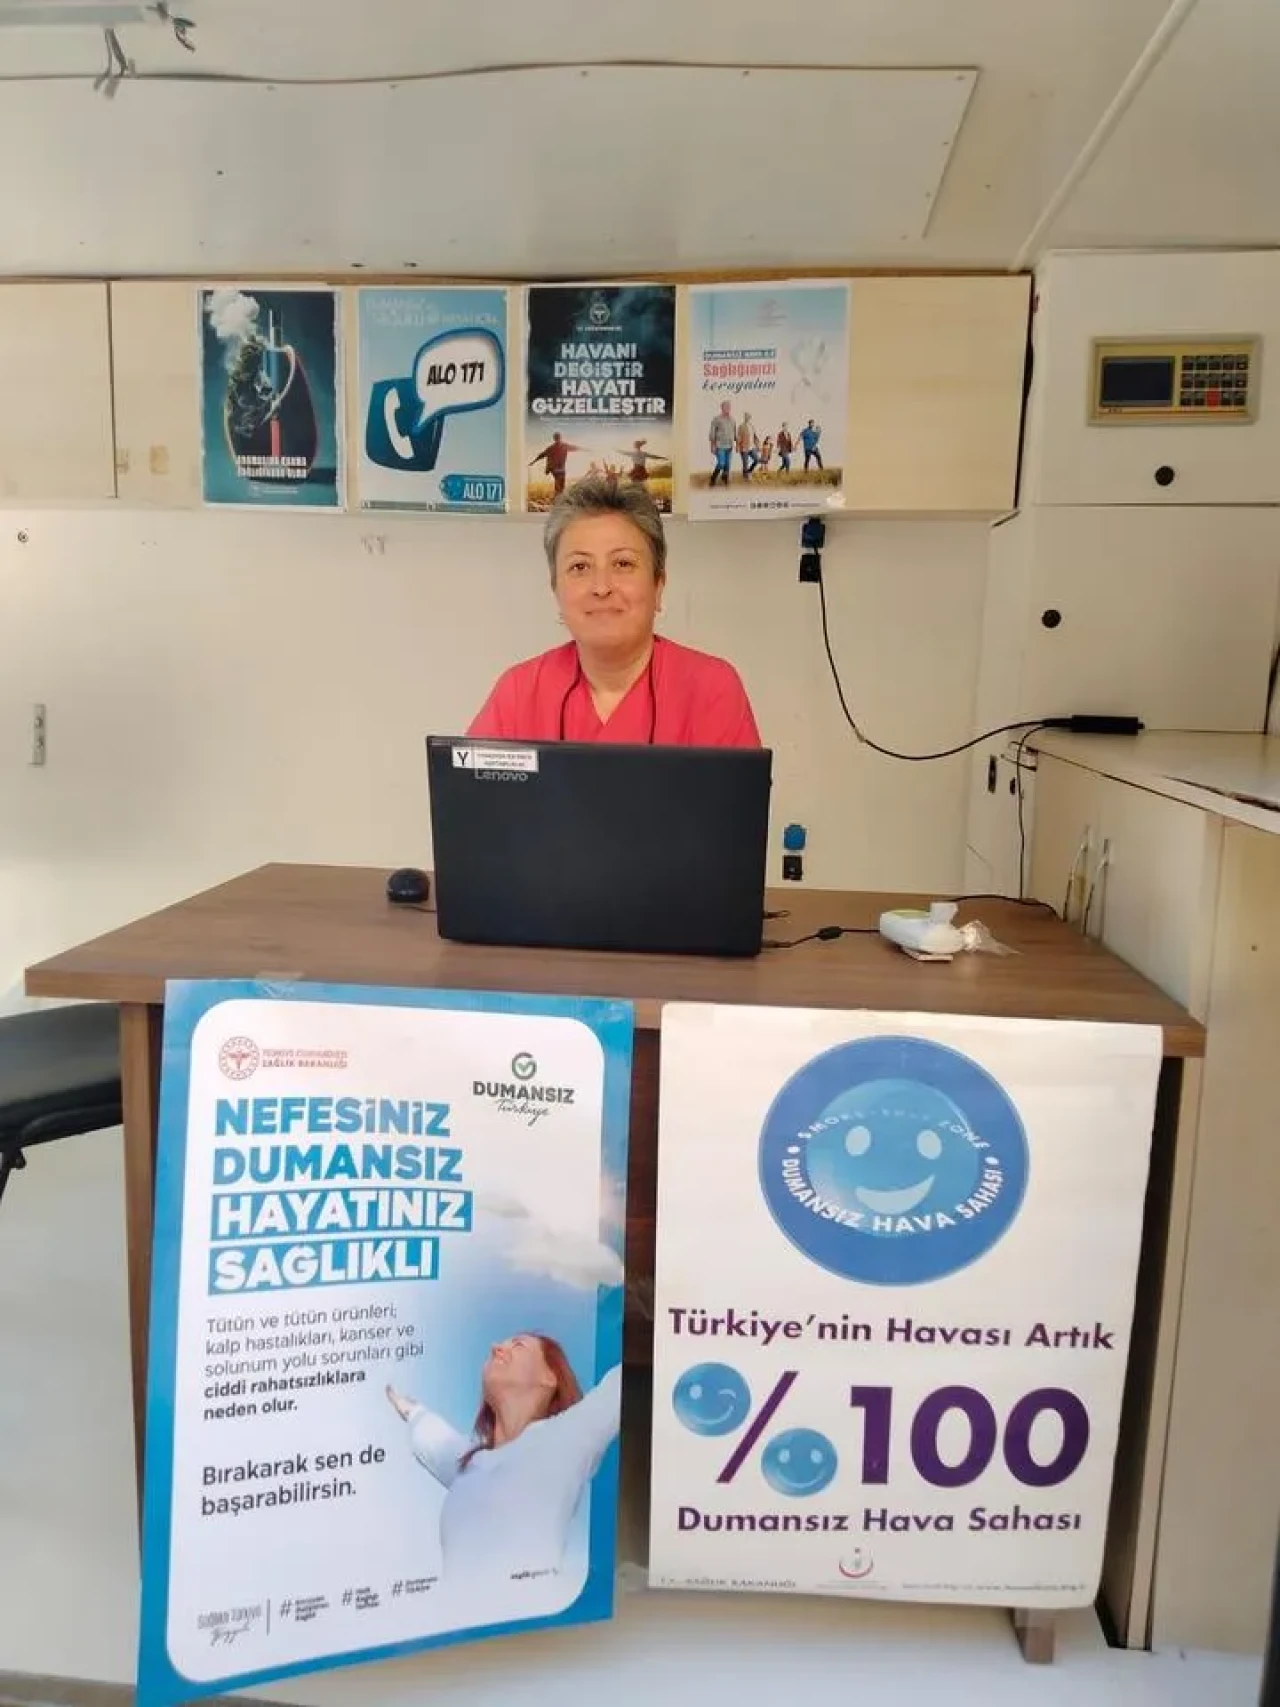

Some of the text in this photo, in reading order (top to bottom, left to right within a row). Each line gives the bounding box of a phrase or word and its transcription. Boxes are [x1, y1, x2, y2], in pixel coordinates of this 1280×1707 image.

[561, 342, 638, 360] HAVANI
[426, 361, 485, 386] ALO 171
[561, 379, 636, 396] HAYATI
[463, 483, 484, 499] ALO
[456, 751, 469, 767] Y
[474, 768, 529, 782] Lenovo
[472, 1080, 576, 1105] DUMANSIZ
[212, 1143, 464, 1186] DUMANSIZ
[781, 1157, 1004, 1233] DUMANSIZ HAVA SAHASI
[217, 1189, 466, 1237] HAYATINIZ
[206, 1314, 255, 1333] Tütün
[259, 1316, 280, 1329] ve
[284, 1309, 328, 1328] tütün
[886, 1317, 1012, 1346] Havası
[1025, 1321, 1116, 1350] Artık
[205, 1323, 415, 1357] kalp hastalıkları, kanser ve
[205, 1341, 425, 1378] solunum yolu sorunları gibi
[203, 1368, 367, 1399] ciddi rahatsızlıklara
[203, 1396, 299, 1421] neden olur.
[202, 1443, 386, 1486] Bırakarak sen de
[201, 1477, 357, 1517] başarabilirsin.
[677, 1504, 1082, 1532] Dumansız Hava Sahası
